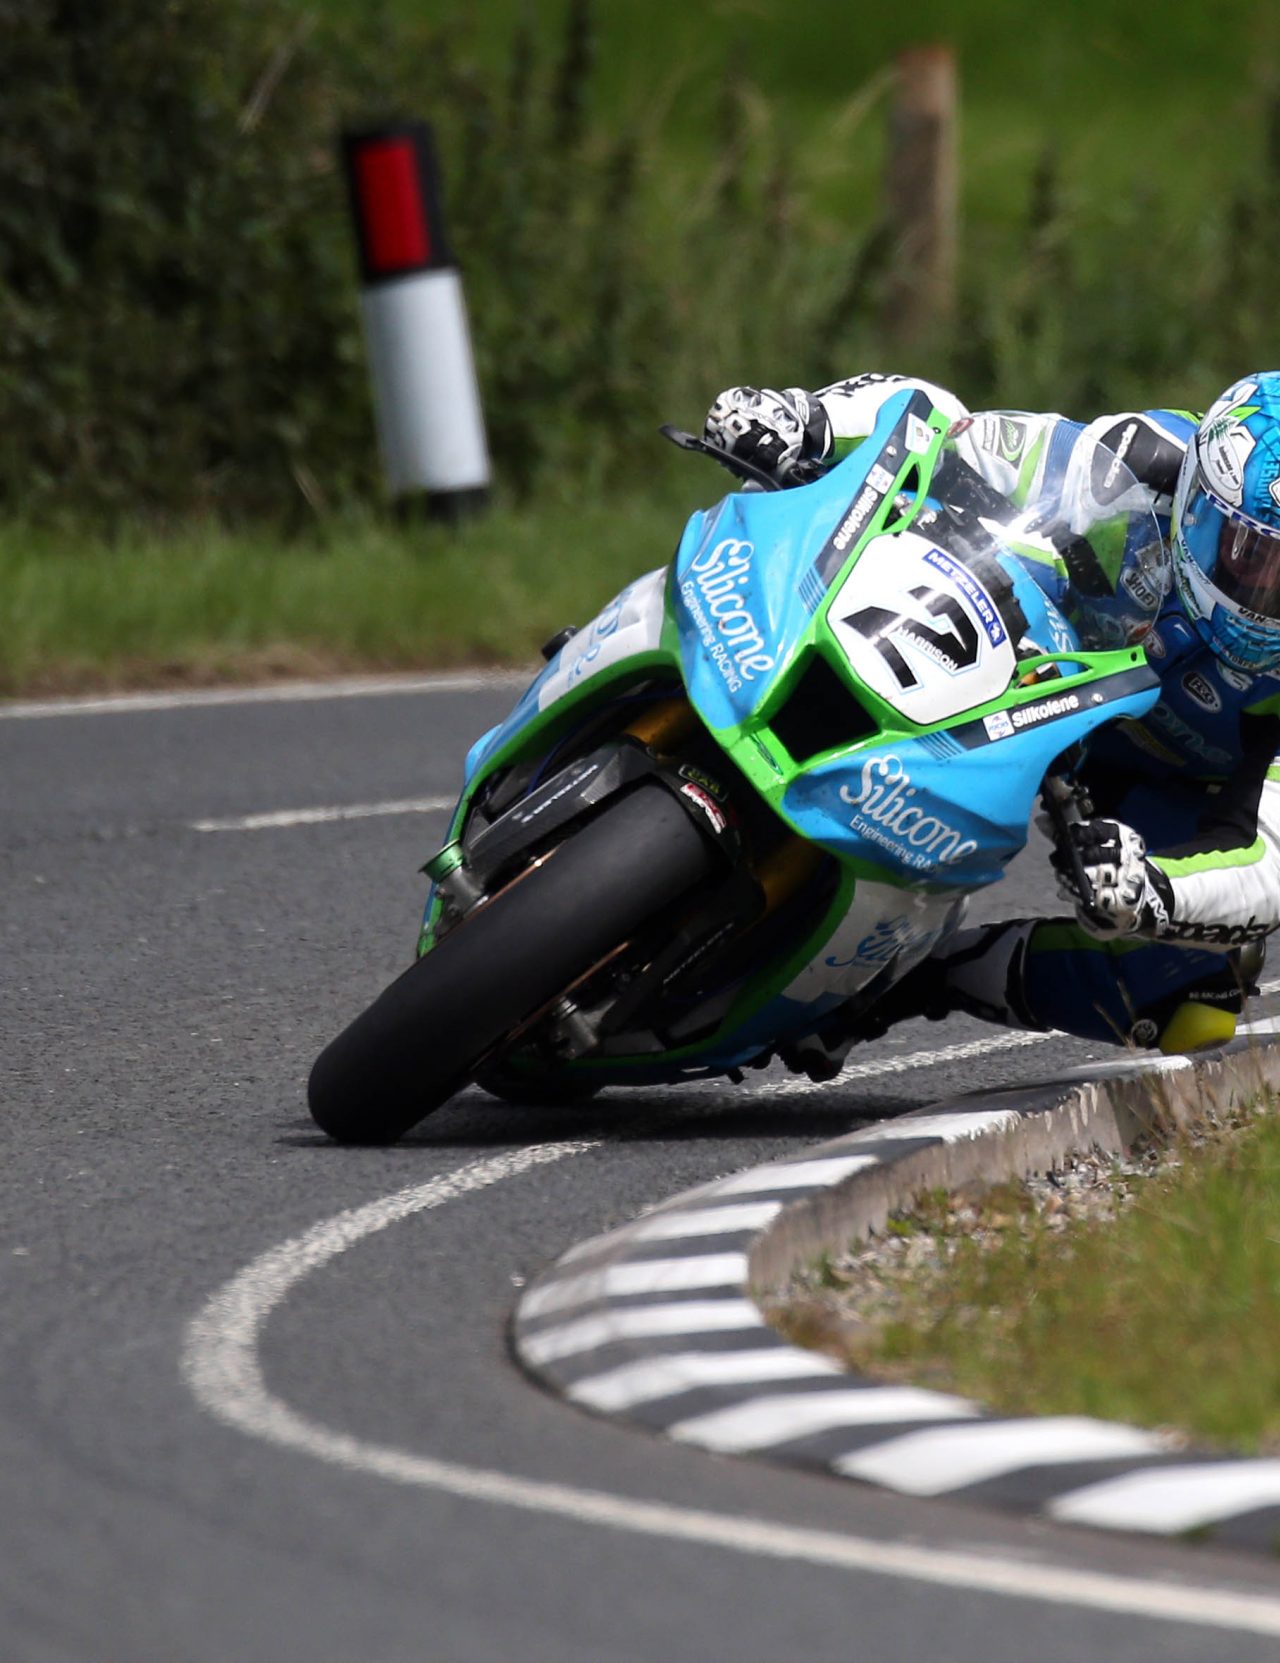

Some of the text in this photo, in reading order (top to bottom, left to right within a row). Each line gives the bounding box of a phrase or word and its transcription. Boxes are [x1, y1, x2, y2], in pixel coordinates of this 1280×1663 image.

[833, 486, 878, 551] Silkolene
[692, 538, 775, 681] Silicone
[928, 551, 995, 624] METZELER
[681, 580, 743, 693] Engineering RACING
[841, 585, 979, 689] 12
[899, 625, 958, 672] HARRISON
[1011, 694, 1079, 728] Silkolene
[840, 754, 977, 864] Silicone
[849, 814, 914, 865] Engineering
